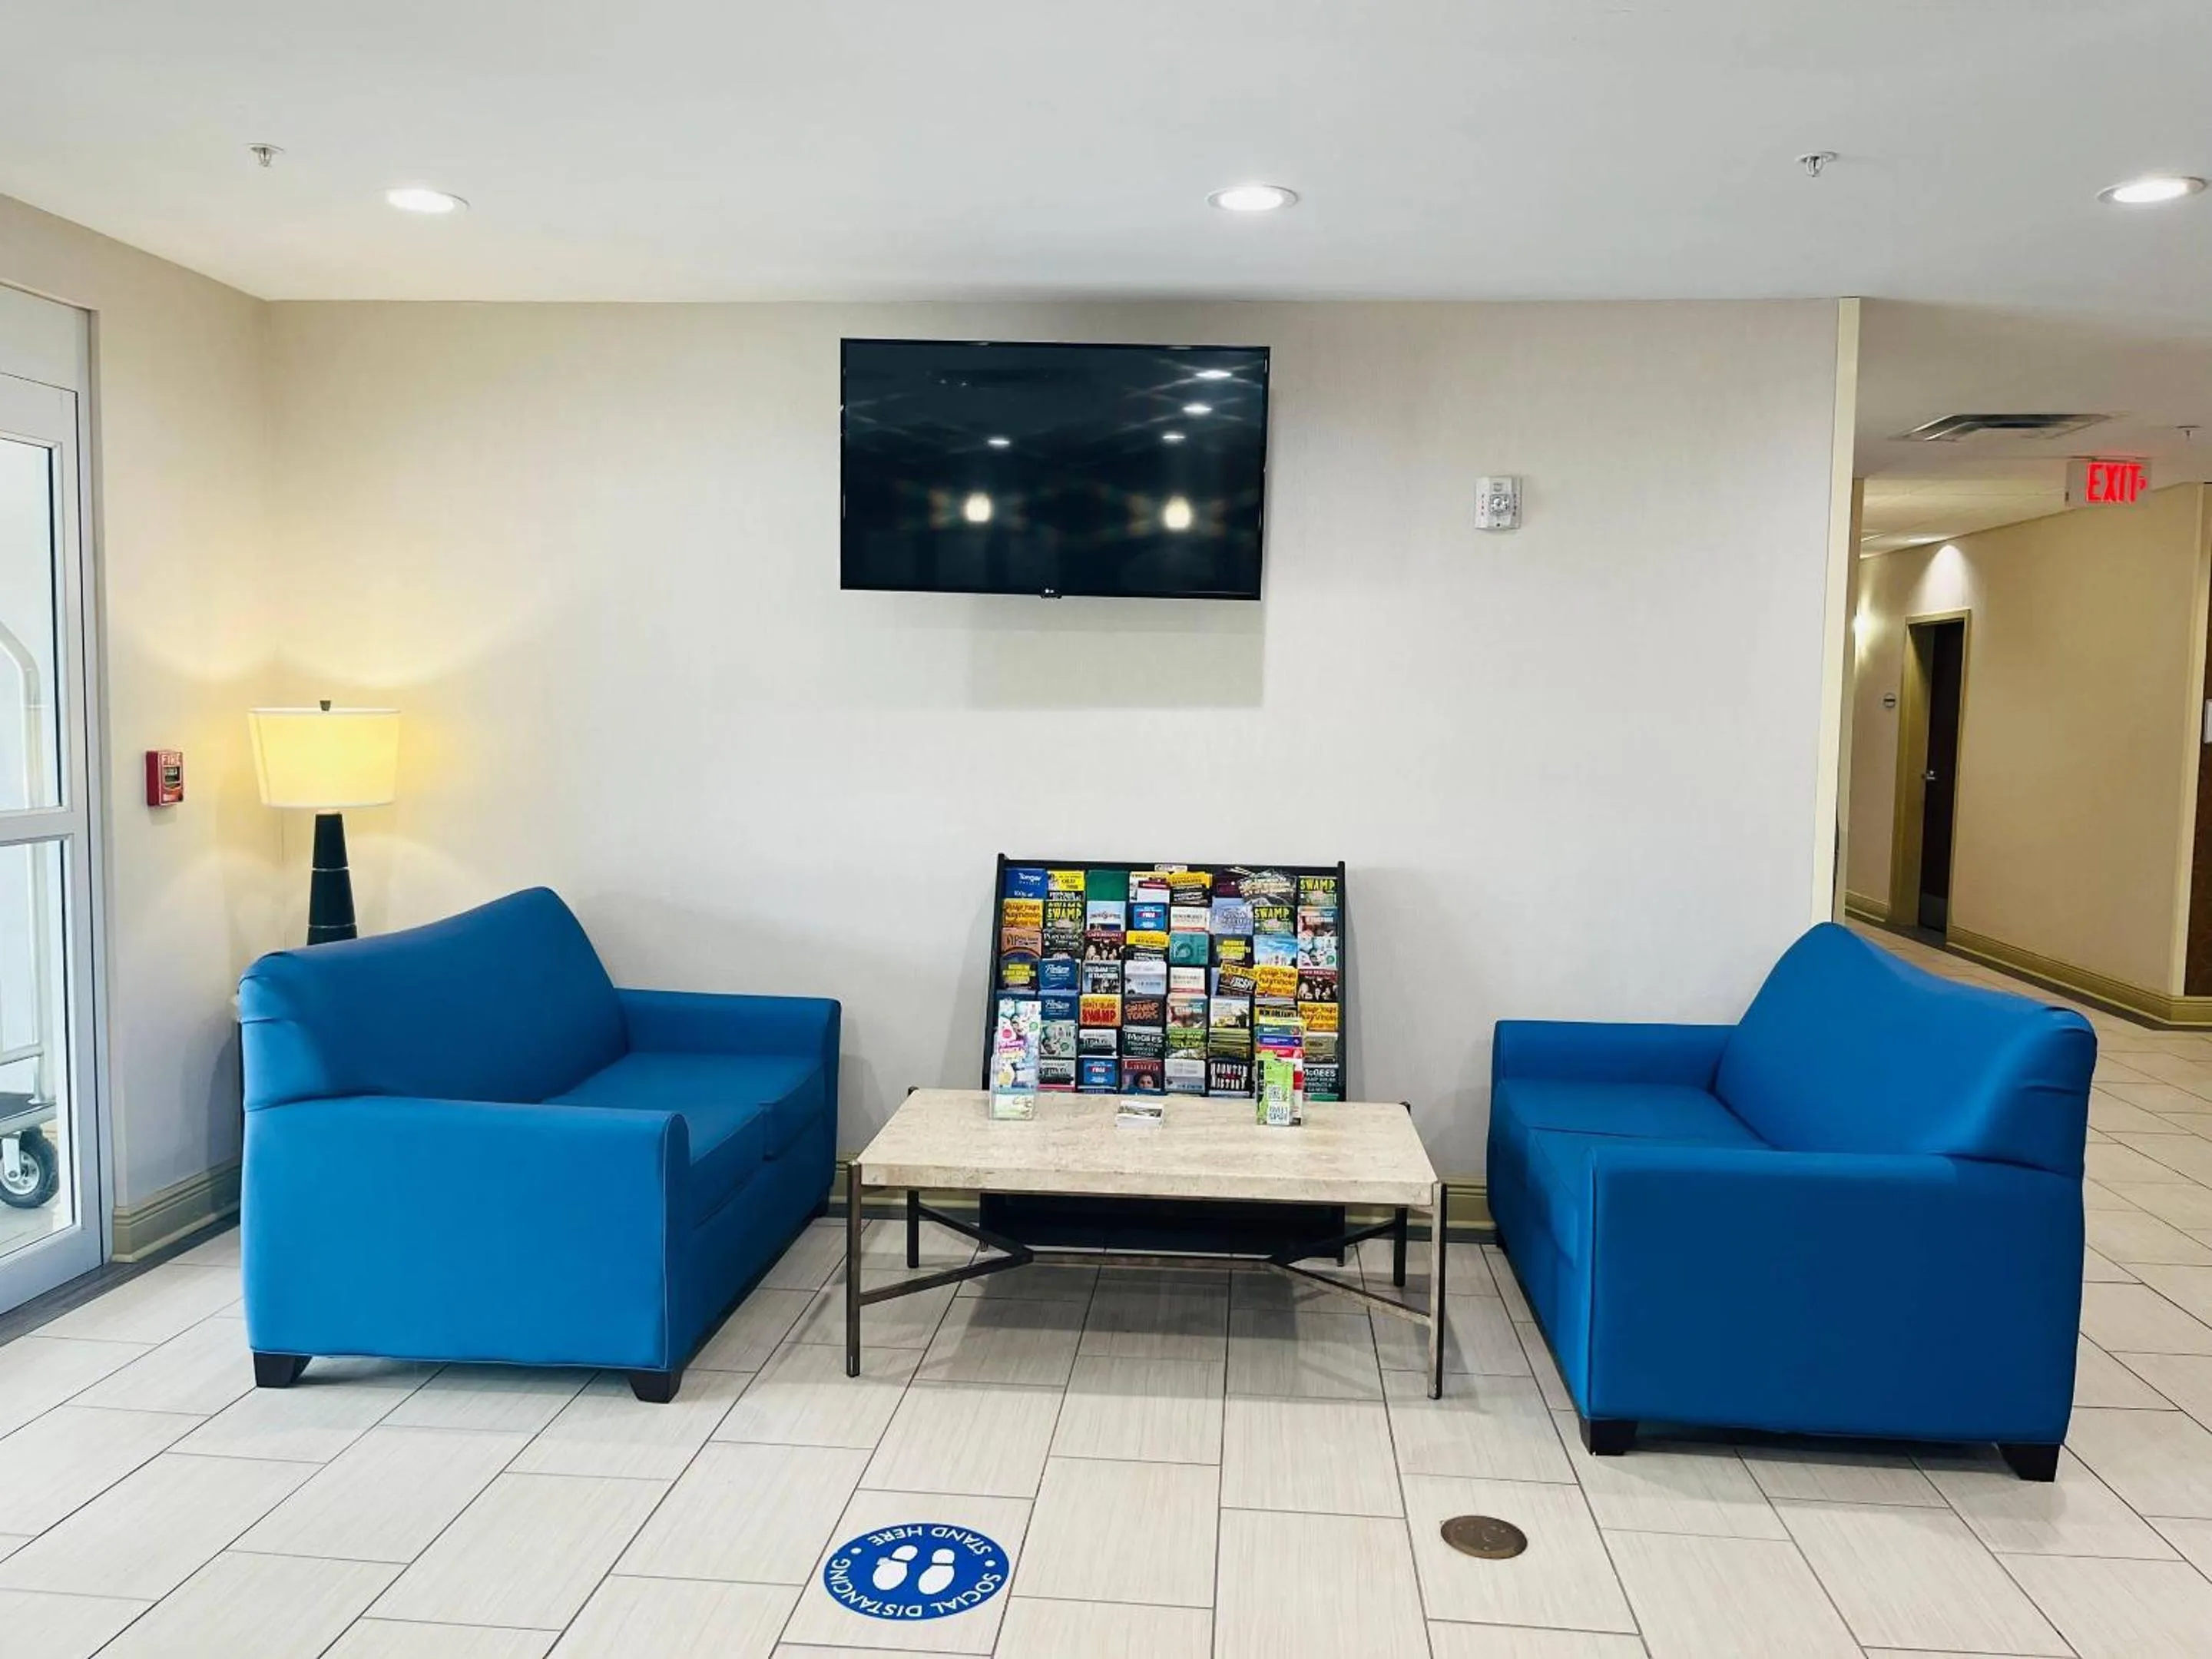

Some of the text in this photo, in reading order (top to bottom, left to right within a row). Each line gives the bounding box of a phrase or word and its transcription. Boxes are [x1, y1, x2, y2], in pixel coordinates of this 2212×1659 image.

[2087, 462, 2142, 504] EXIT
[1300, 879, 1335, 891] SWAMP
[1047, 908, 1082, 920] SWAMP
[1254, 907, 1290, 919] SWAMP
[1124, 1002, 1159, 1014] SWAMP
[1082, 1008, 1116, 1022] SWAMP
[1126, 1011, 1159, 1020] TOURS
[1124, 1061, 1158, 1071] Laura
[1210, 1063, 1248, 1077] HAUNTED
[1210, 1076, 1247, 1090] HISTORY
[868, 1526, 992, 1555] STAND HERE
[830, 1558, 1001, 1617] SOCIAL DISTANCING
